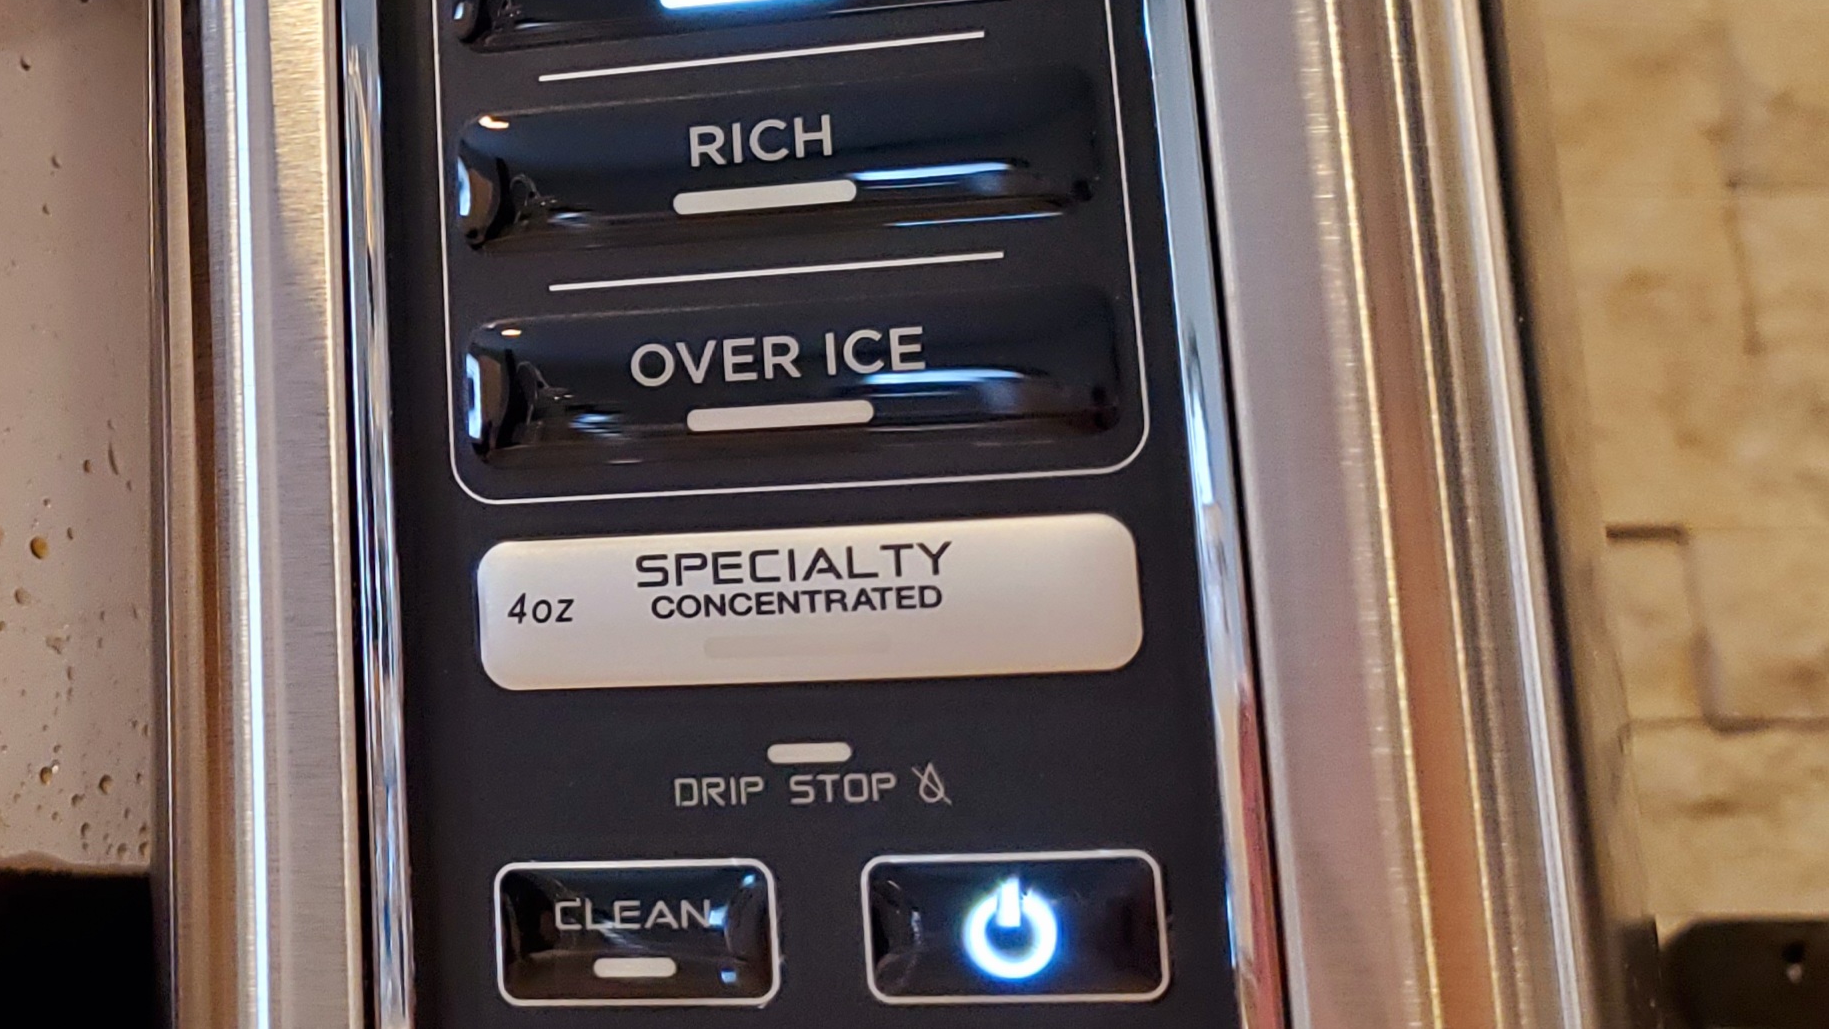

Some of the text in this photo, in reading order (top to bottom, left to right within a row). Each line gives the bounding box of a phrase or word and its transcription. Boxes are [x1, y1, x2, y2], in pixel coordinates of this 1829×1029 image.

[688, 113, 834, 168] RICH
[629, 326, 927, 388] OVER ICE
[635, 540, 954, 588] SPECIALTY
[507, 591, 576, 625] 4oz
[650, 584, 944, 620] CONCENTRATED
[673, 771, 897, 808] DRIP STOP
[553, 897, 714, 933] CLEAN
